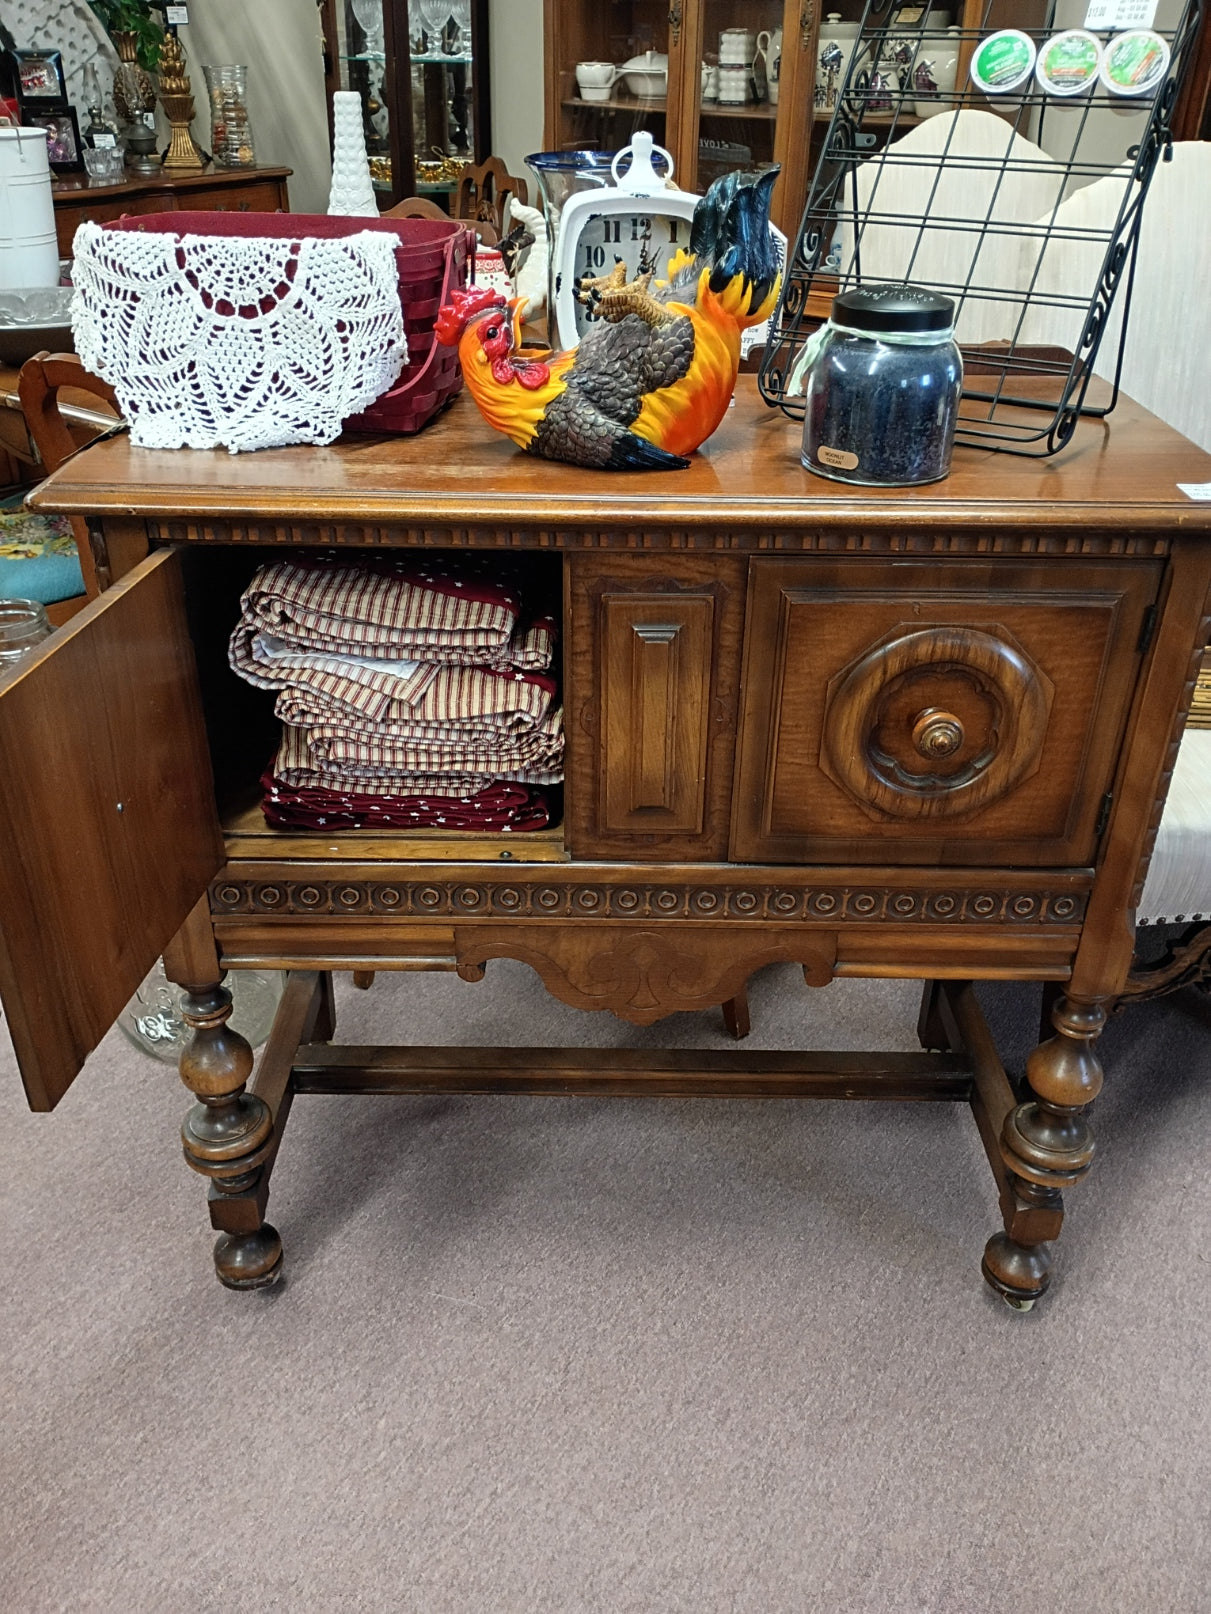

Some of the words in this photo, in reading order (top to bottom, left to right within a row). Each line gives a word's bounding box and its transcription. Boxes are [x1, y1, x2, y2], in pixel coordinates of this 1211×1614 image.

[603, 220, 621, 243] 11
[630, 218, 652, 240] 12
[668, 221, 678, 243] 1
[585, 245, 605, 268] 10
